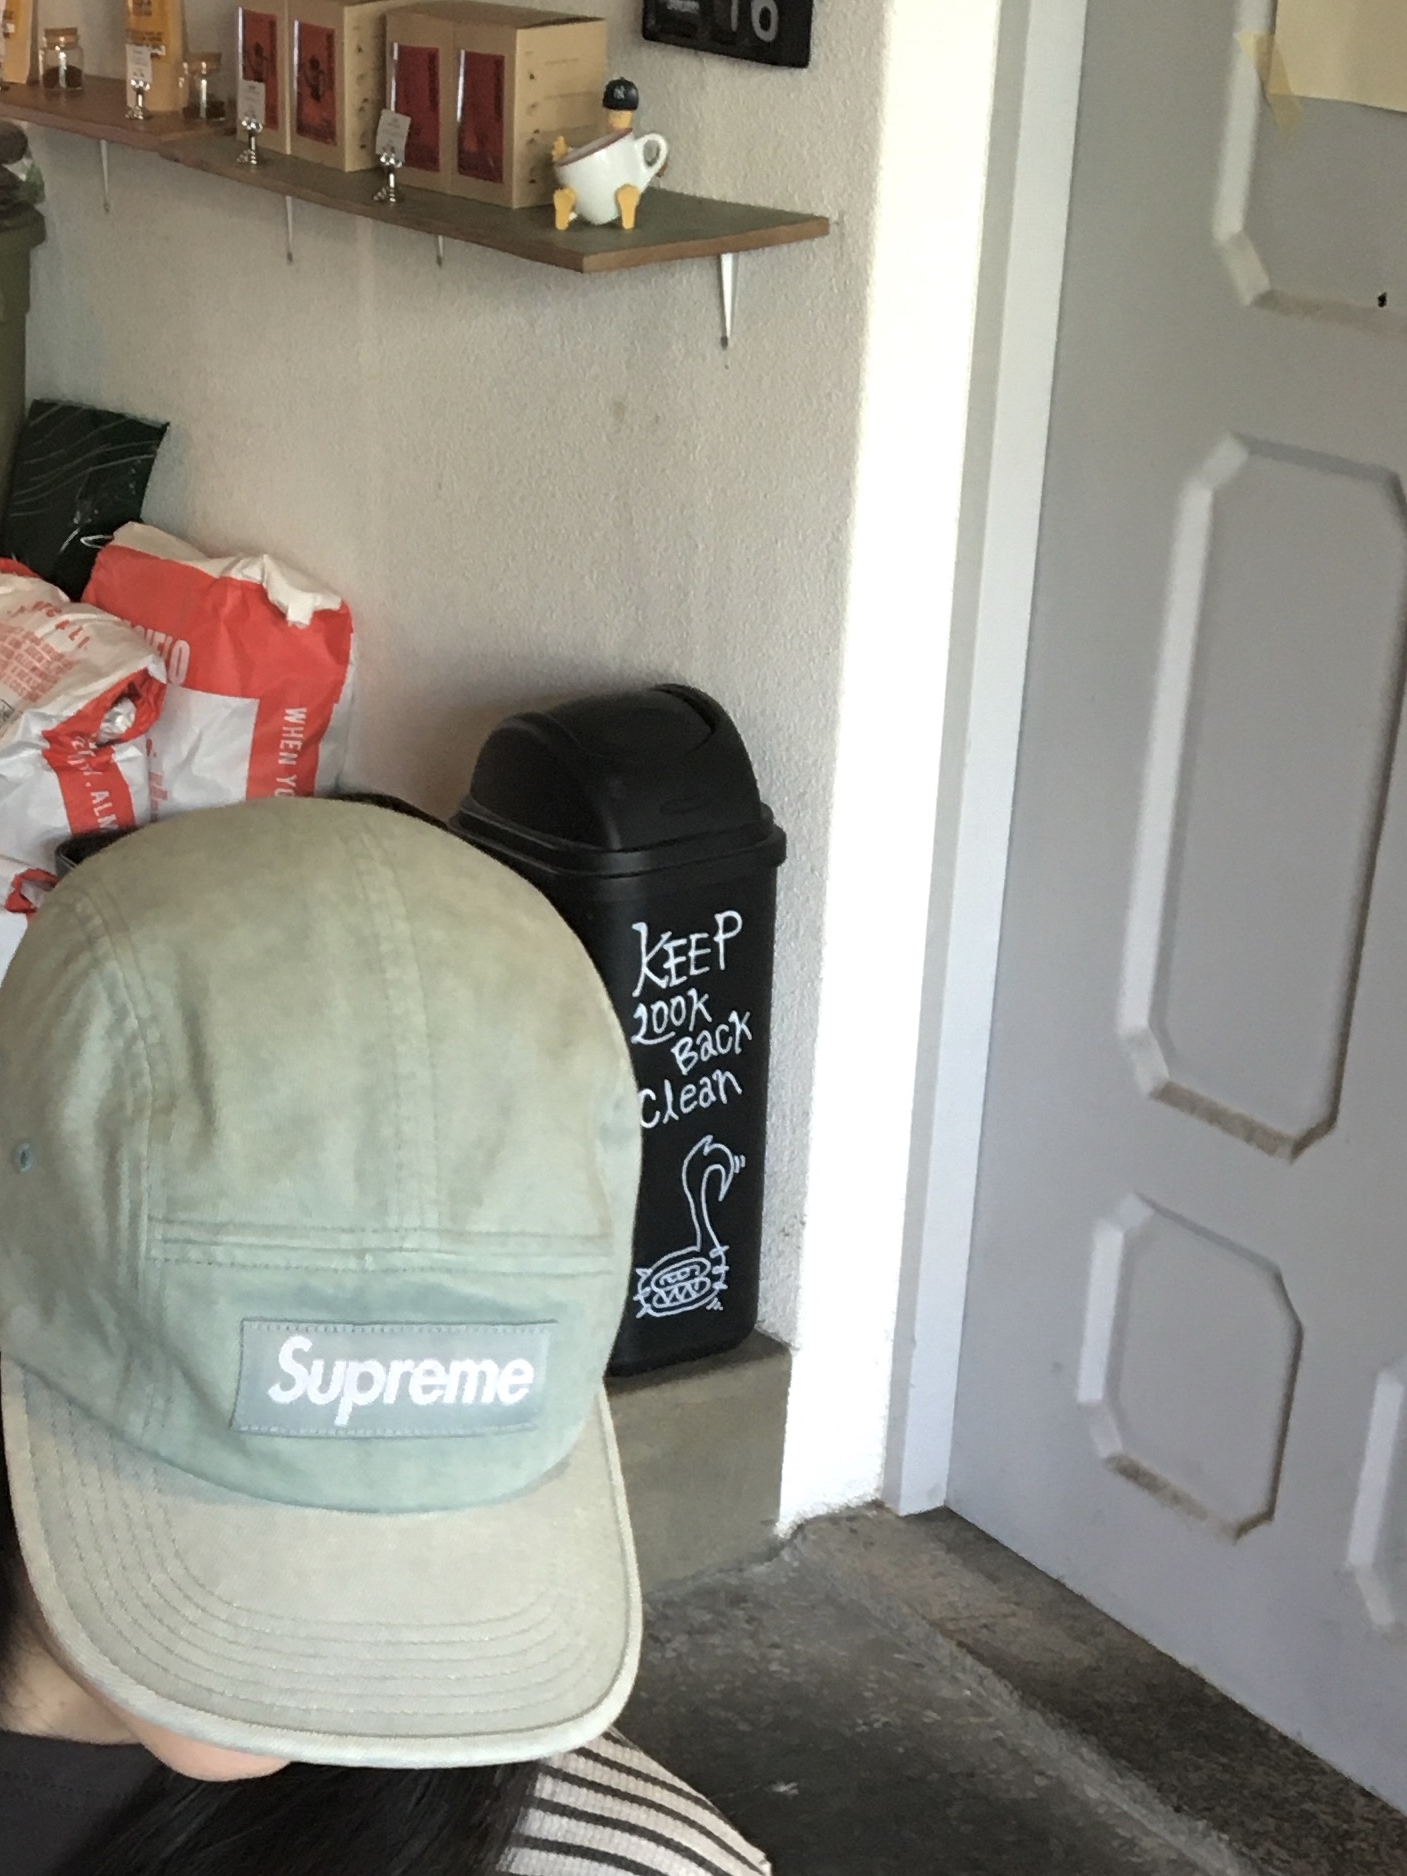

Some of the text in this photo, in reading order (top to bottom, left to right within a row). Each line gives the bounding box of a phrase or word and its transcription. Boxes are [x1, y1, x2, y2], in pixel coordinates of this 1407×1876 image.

[277, 707, 308, 766] WHEN
[631, 910, 743, 998] KEEP
[267, 1335, 534, 1427] Supreme
